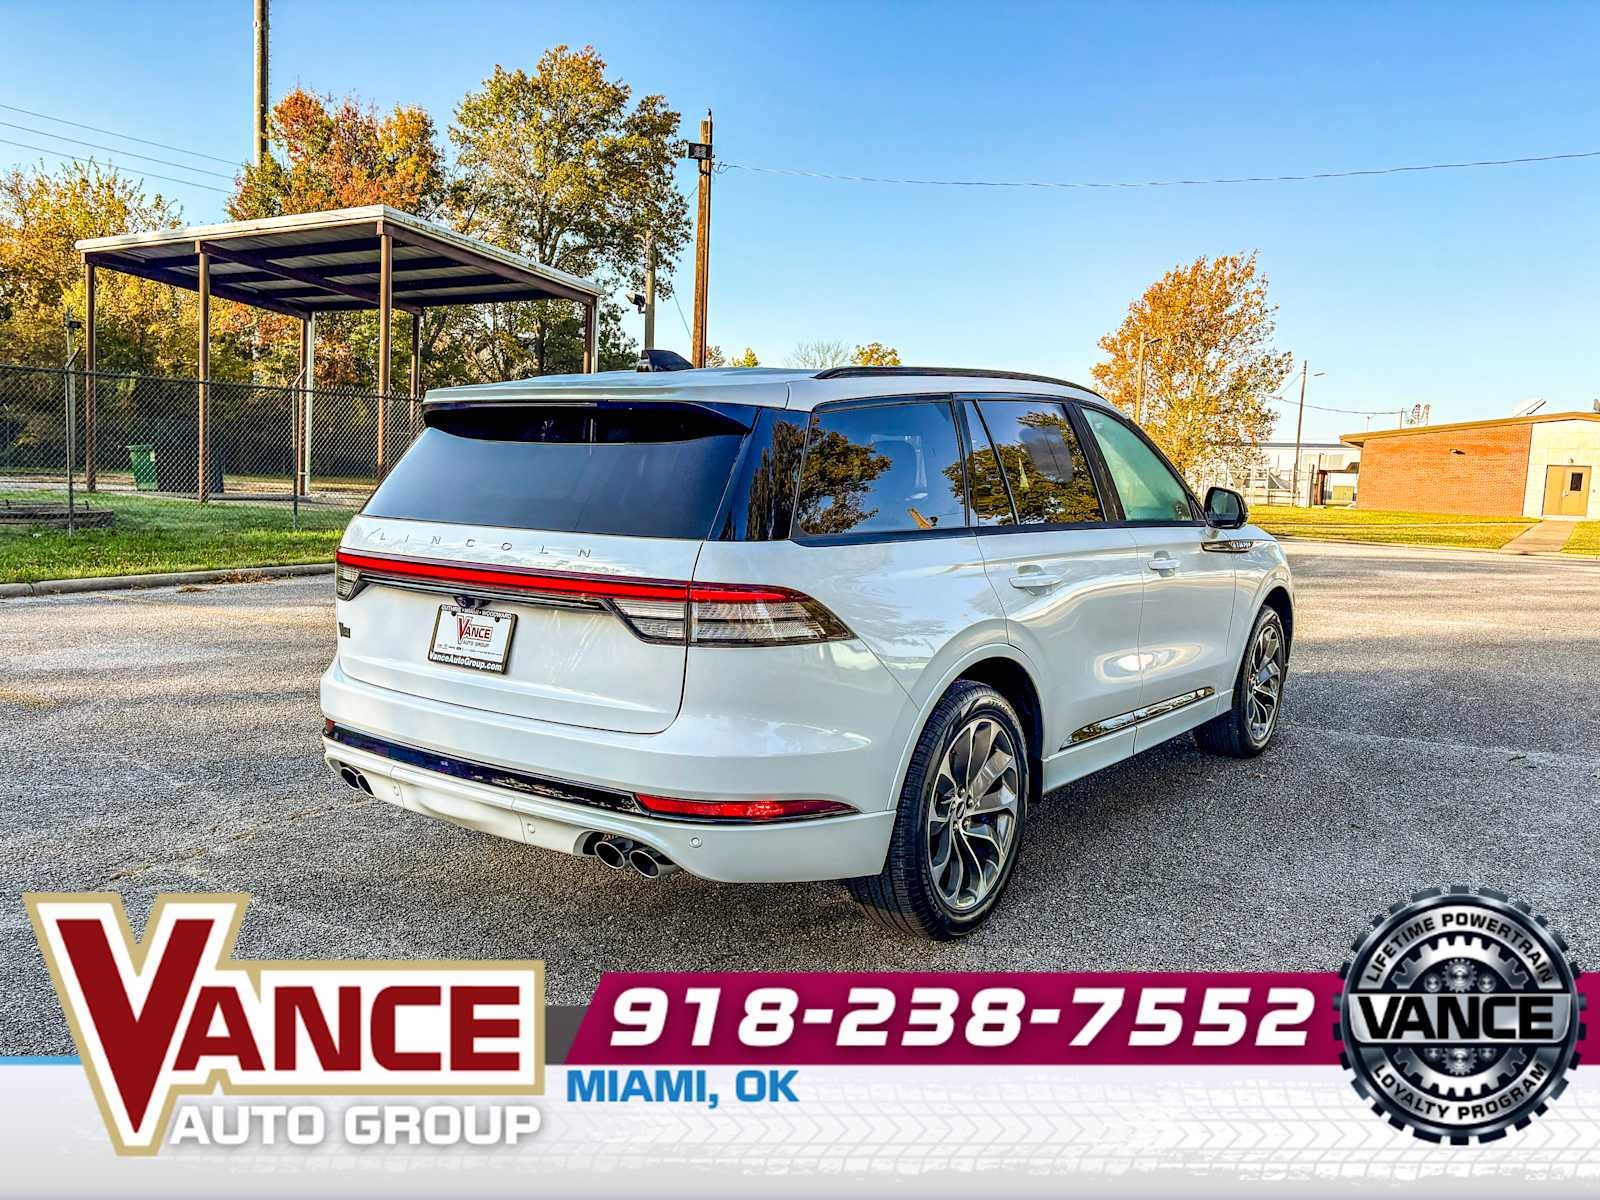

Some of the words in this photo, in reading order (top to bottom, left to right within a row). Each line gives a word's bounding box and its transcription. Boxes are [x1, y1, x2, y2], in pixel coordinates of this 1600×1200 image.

[379, 532, 591, 558] LINCOLN
[457, 617, 491, 641] VANCE
[430, 652, 502, 671] VanceAutoGroup.com
